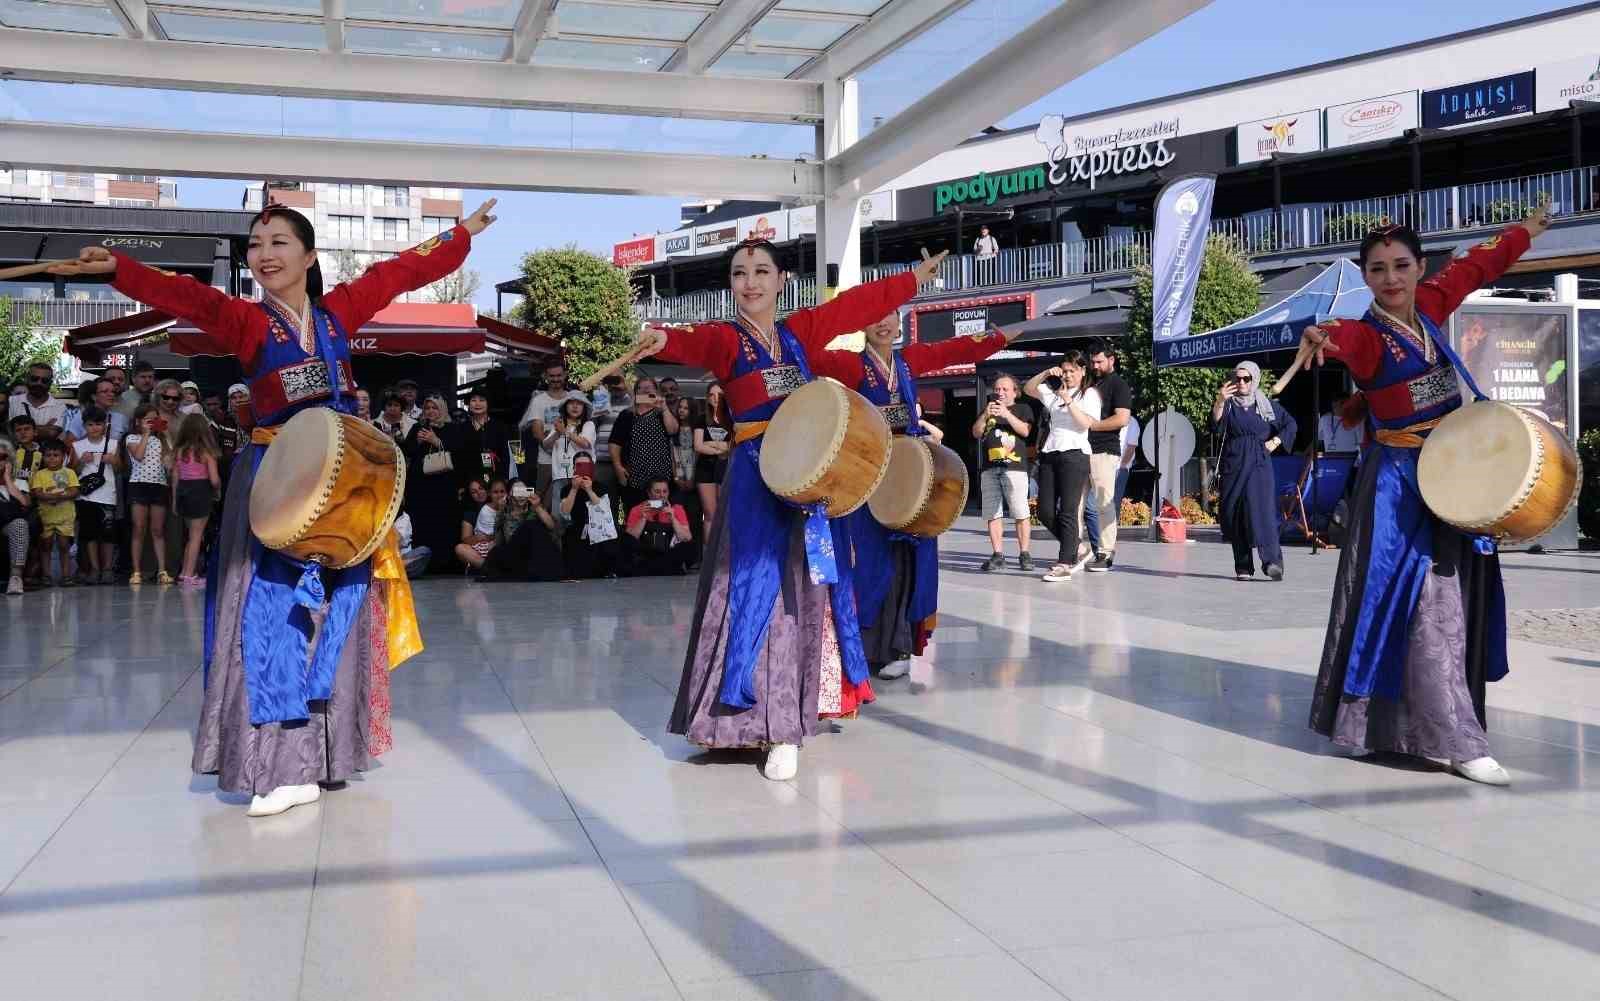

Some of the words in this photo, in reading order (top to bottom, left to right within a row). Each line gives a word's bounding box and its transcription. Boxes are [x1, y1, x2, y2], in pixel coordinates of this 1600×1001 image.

[935, 166, 1045, 212] podyum
[1048, 138, 1176, 190] Express
[667, 238, 687, 250] AKAY
[954, 309, 986, 321] PODYUM
[1161, 291, 1184, 336] BURSA
[347, 338, 377, 350] KIZ
[1181, 337, 1216, 358] BURSA
[1492, 368, 1499, 383] 1
[1500, 368, 1540, 383] ALANA
[1490, 386, 1498, 401] 1
[1499, 386, 1546, 401] BEDAVA
